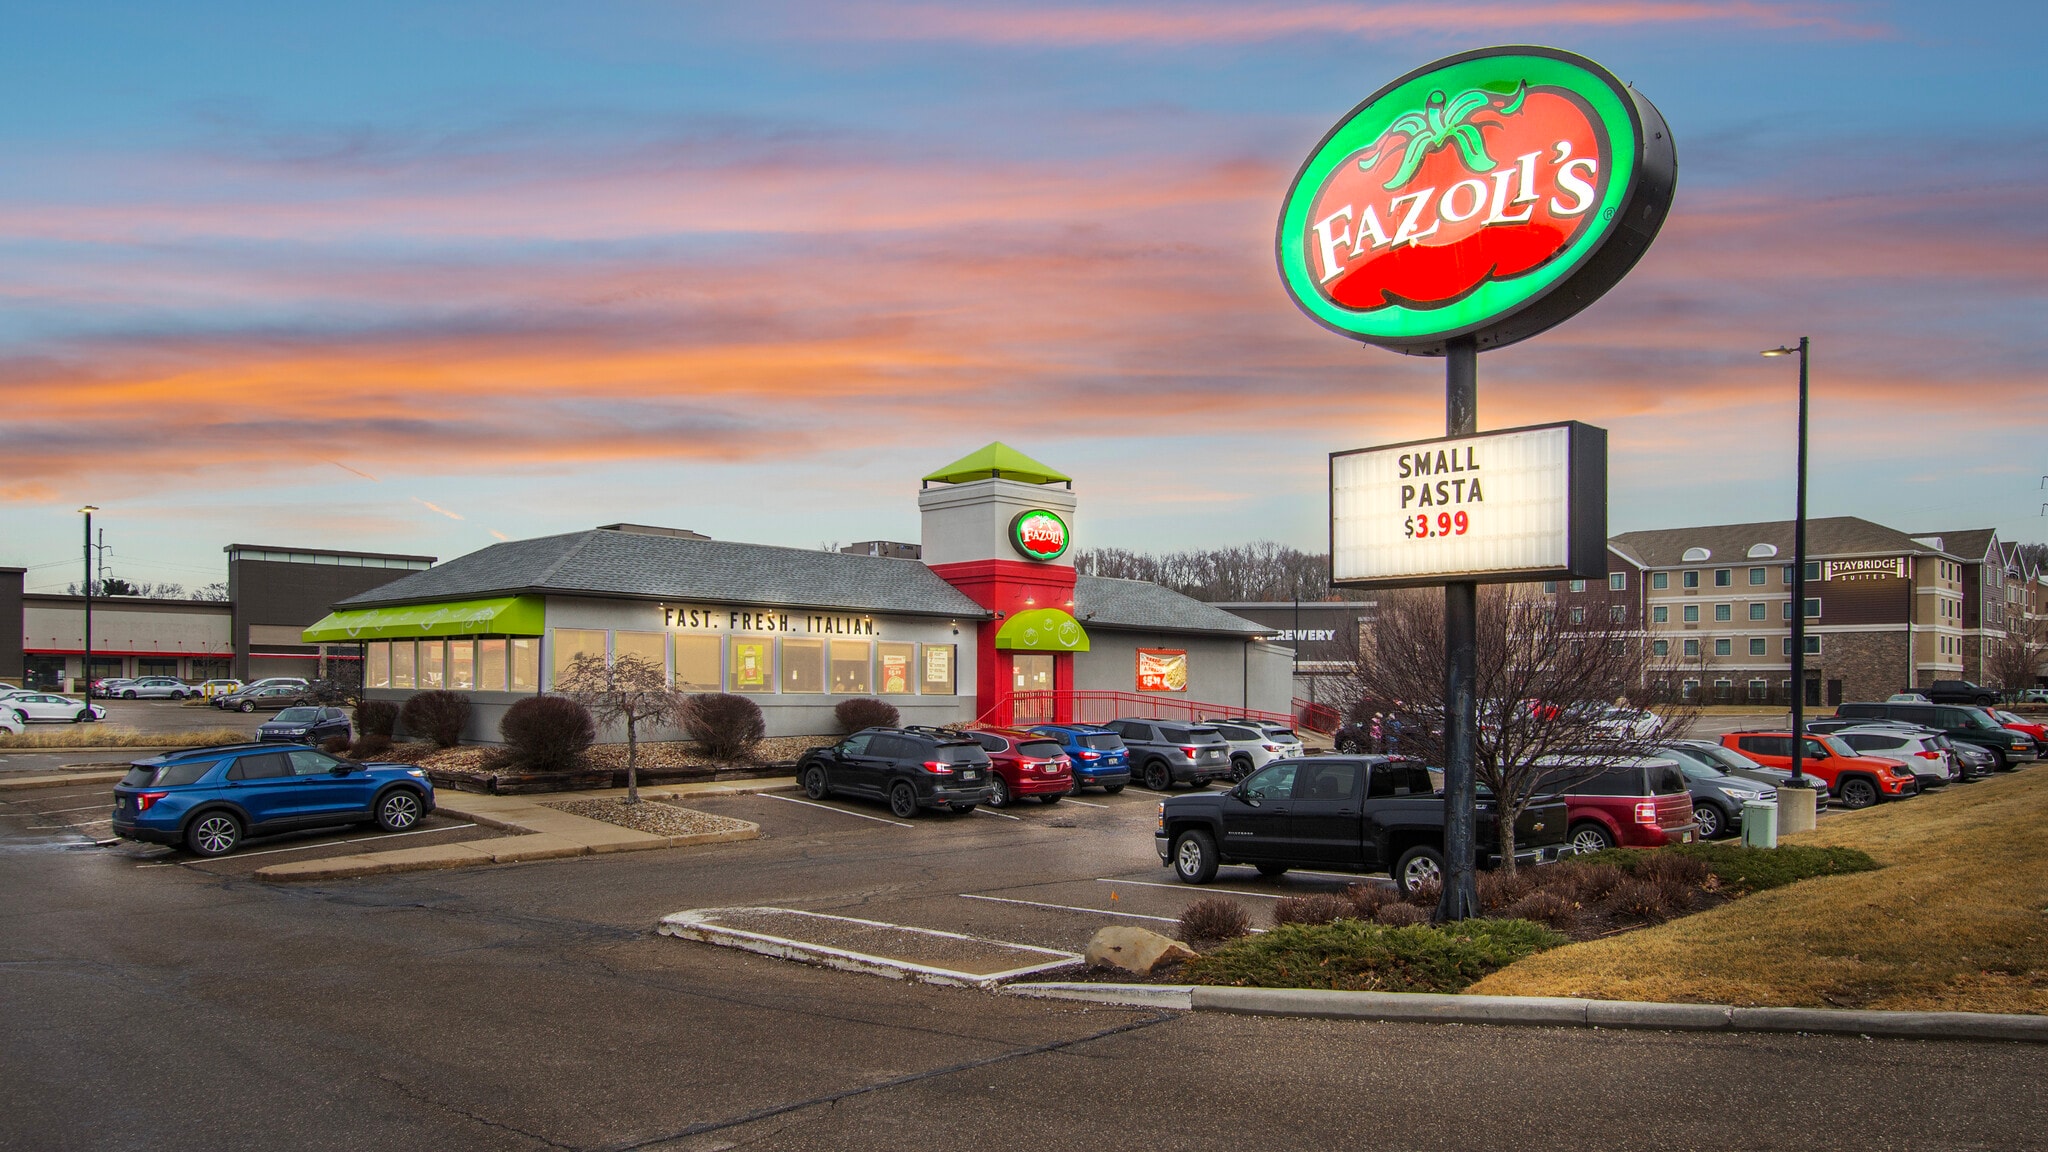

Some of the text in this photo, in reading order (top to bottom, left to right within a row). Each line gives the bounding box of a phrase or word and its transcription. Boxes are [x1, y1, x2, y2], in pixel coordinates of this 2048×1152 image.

[1312, 141, 1598, 286] FAZOLI'S
[1399, 446, 1480, 478] SMALL
[1401, 478, 1483, 509] PASTA
[1404, 510, 1469, 539] $3.99
[1832, 559, 1896, 571] STAYBRIDGE
[1841, 573, 1886, 581] SUITES
[665, 608, 880, 636] FAST. FRESH. ITALIAN.
